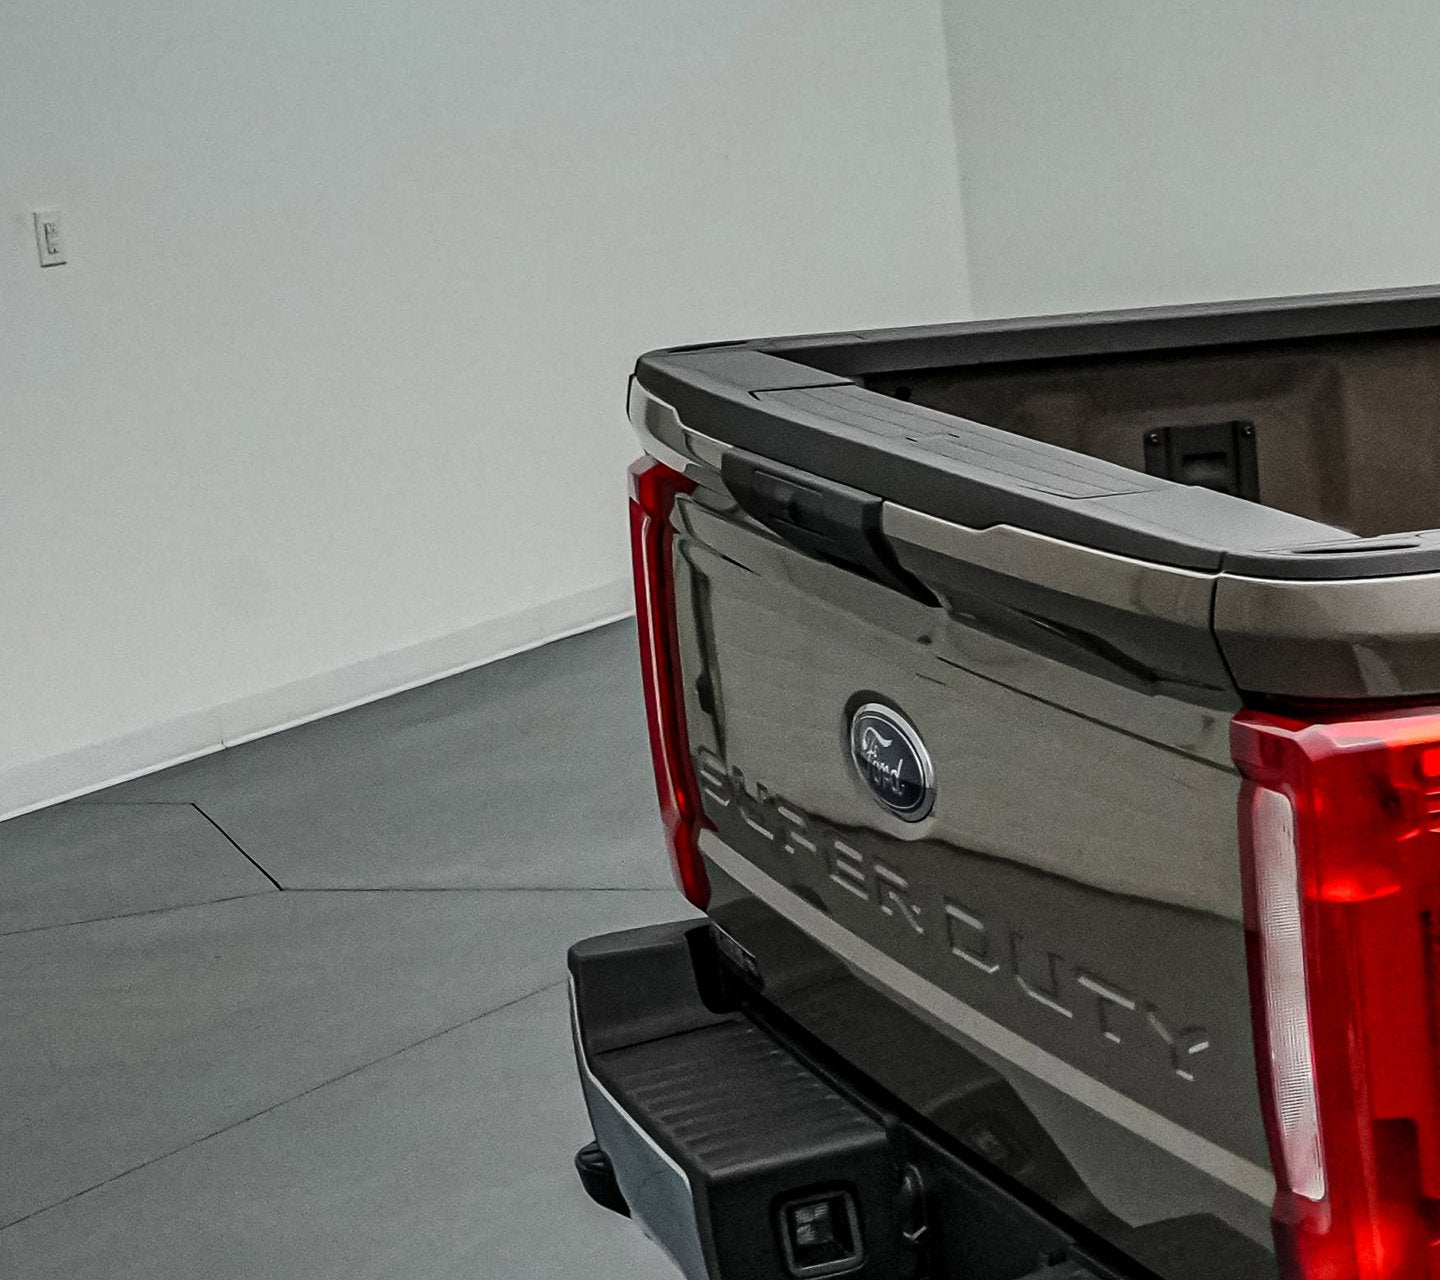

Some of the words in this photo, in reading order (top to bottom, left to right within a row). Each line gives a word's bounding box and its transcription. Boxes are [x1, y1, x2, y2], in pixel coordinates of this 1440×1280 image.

[862, 725, 904, 779] Ford
[696, 744, 925, 935] SUPER
[943, 895, 1210, 1082] DUTY
